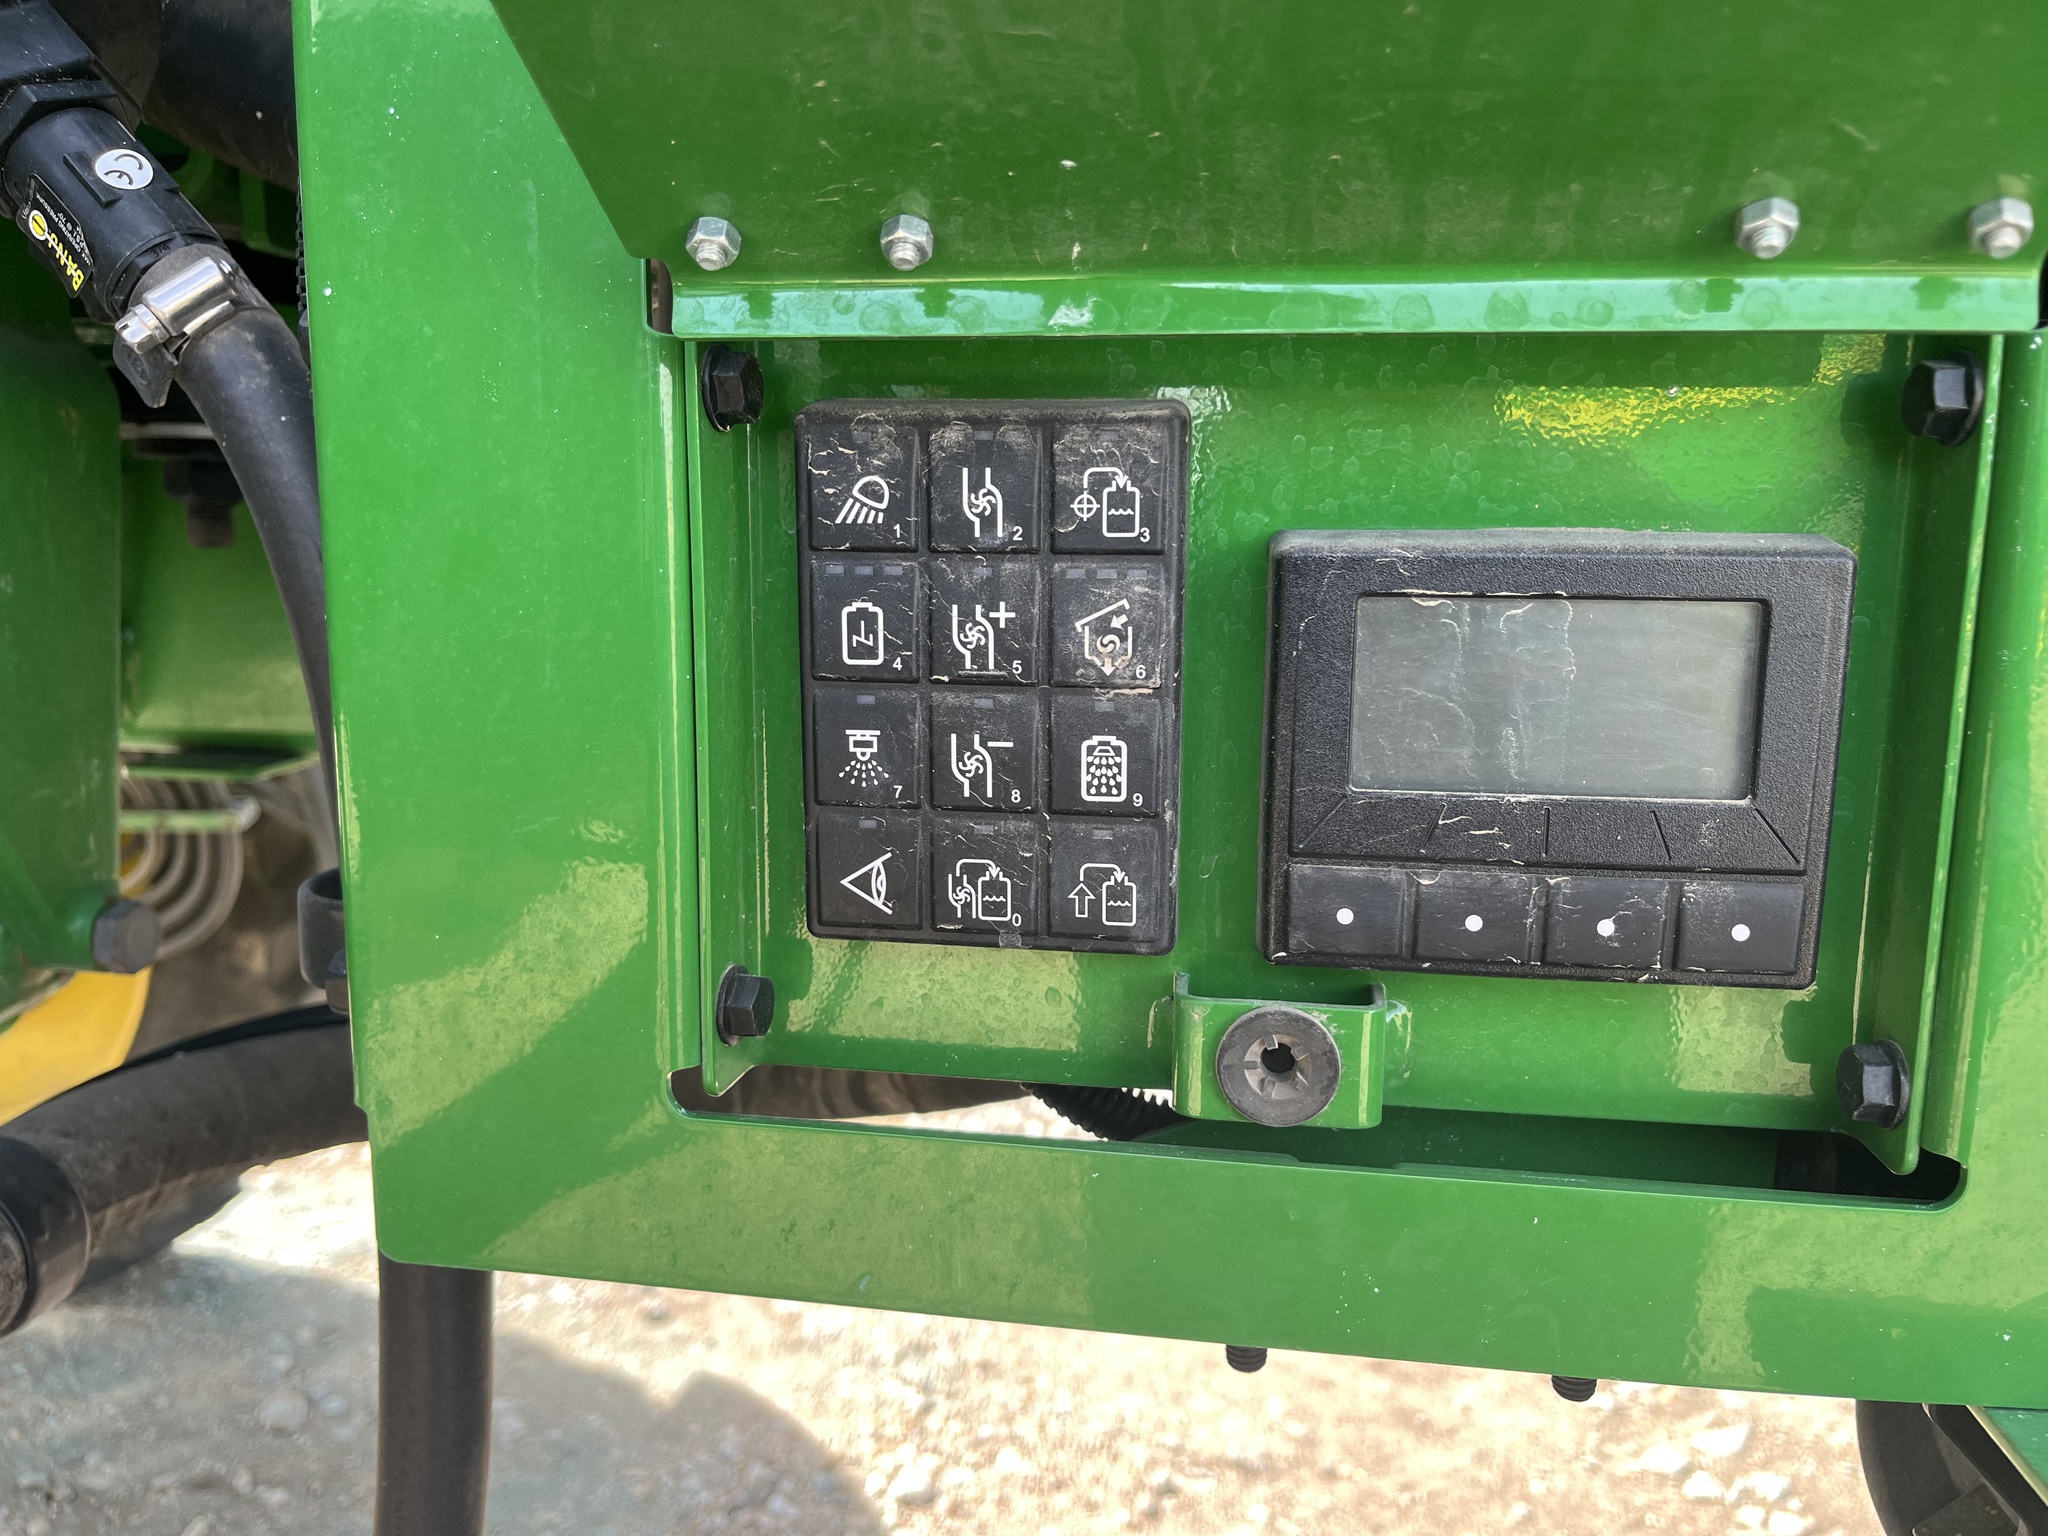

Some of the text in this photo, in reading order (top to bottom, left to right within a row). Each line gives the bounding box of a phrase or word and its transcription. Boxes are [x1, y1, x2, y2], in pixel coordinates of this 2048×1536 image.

[104, 153, 143, 186] CE
[36, 191, 59, 223] PRESSURE
[58, 220, 81, 252] OPERATING
[893, 524, 901, 538] 1
[1012, 526, 1023, 541] 2
[1140, 527, 1151, 543] 3
[892, 657, 903, 671] 4
[1012, 659, 1023, 675] 5
[1135, 664, 1147, 679] 6
[893, 785, 902, 799] 7
[1011, 789, 1021, 804] 8
[1132, 792, 1143, 808] 9
